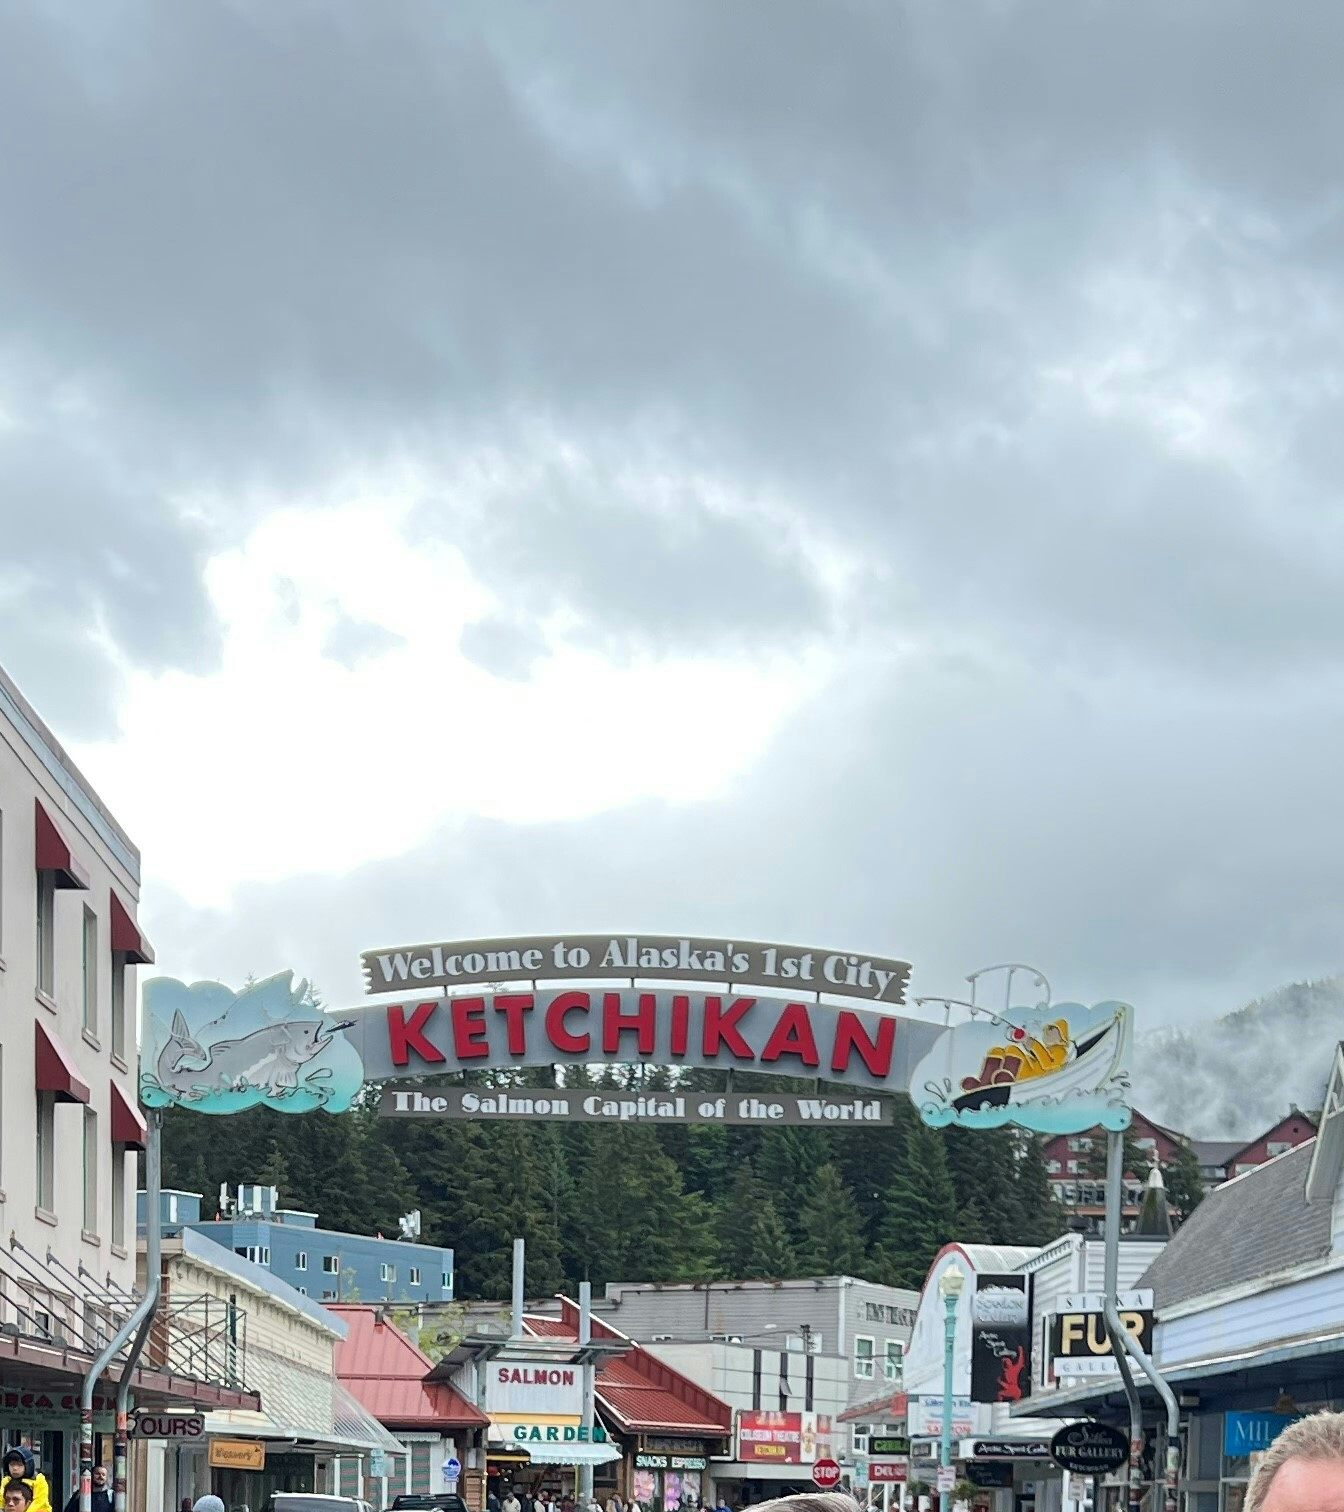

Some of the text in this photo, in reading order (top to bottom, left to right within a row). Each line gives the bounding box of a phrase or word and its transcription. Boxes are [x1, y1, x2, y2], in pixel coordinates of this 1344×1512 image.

[376, 936, 898, 1000] Welcome to Alaska's 1st City
[386, 990, 898, 1078] KETCHIKAN
[391, 1090, 882, 1121] The Salmon Capital of the World
[1061, 1311, 1146, 1355] FUR
[498, 1367, 574, 1386] SALMON
[137, 1418, 202, 1436] OURS
[514, 1425, 607, 1443] GARDEN
[1055, 1445, 1076, 1457] FUR
[636, 1456, 668, 1468] SNACKS
[813, 1466, 839, 1479] STOP
